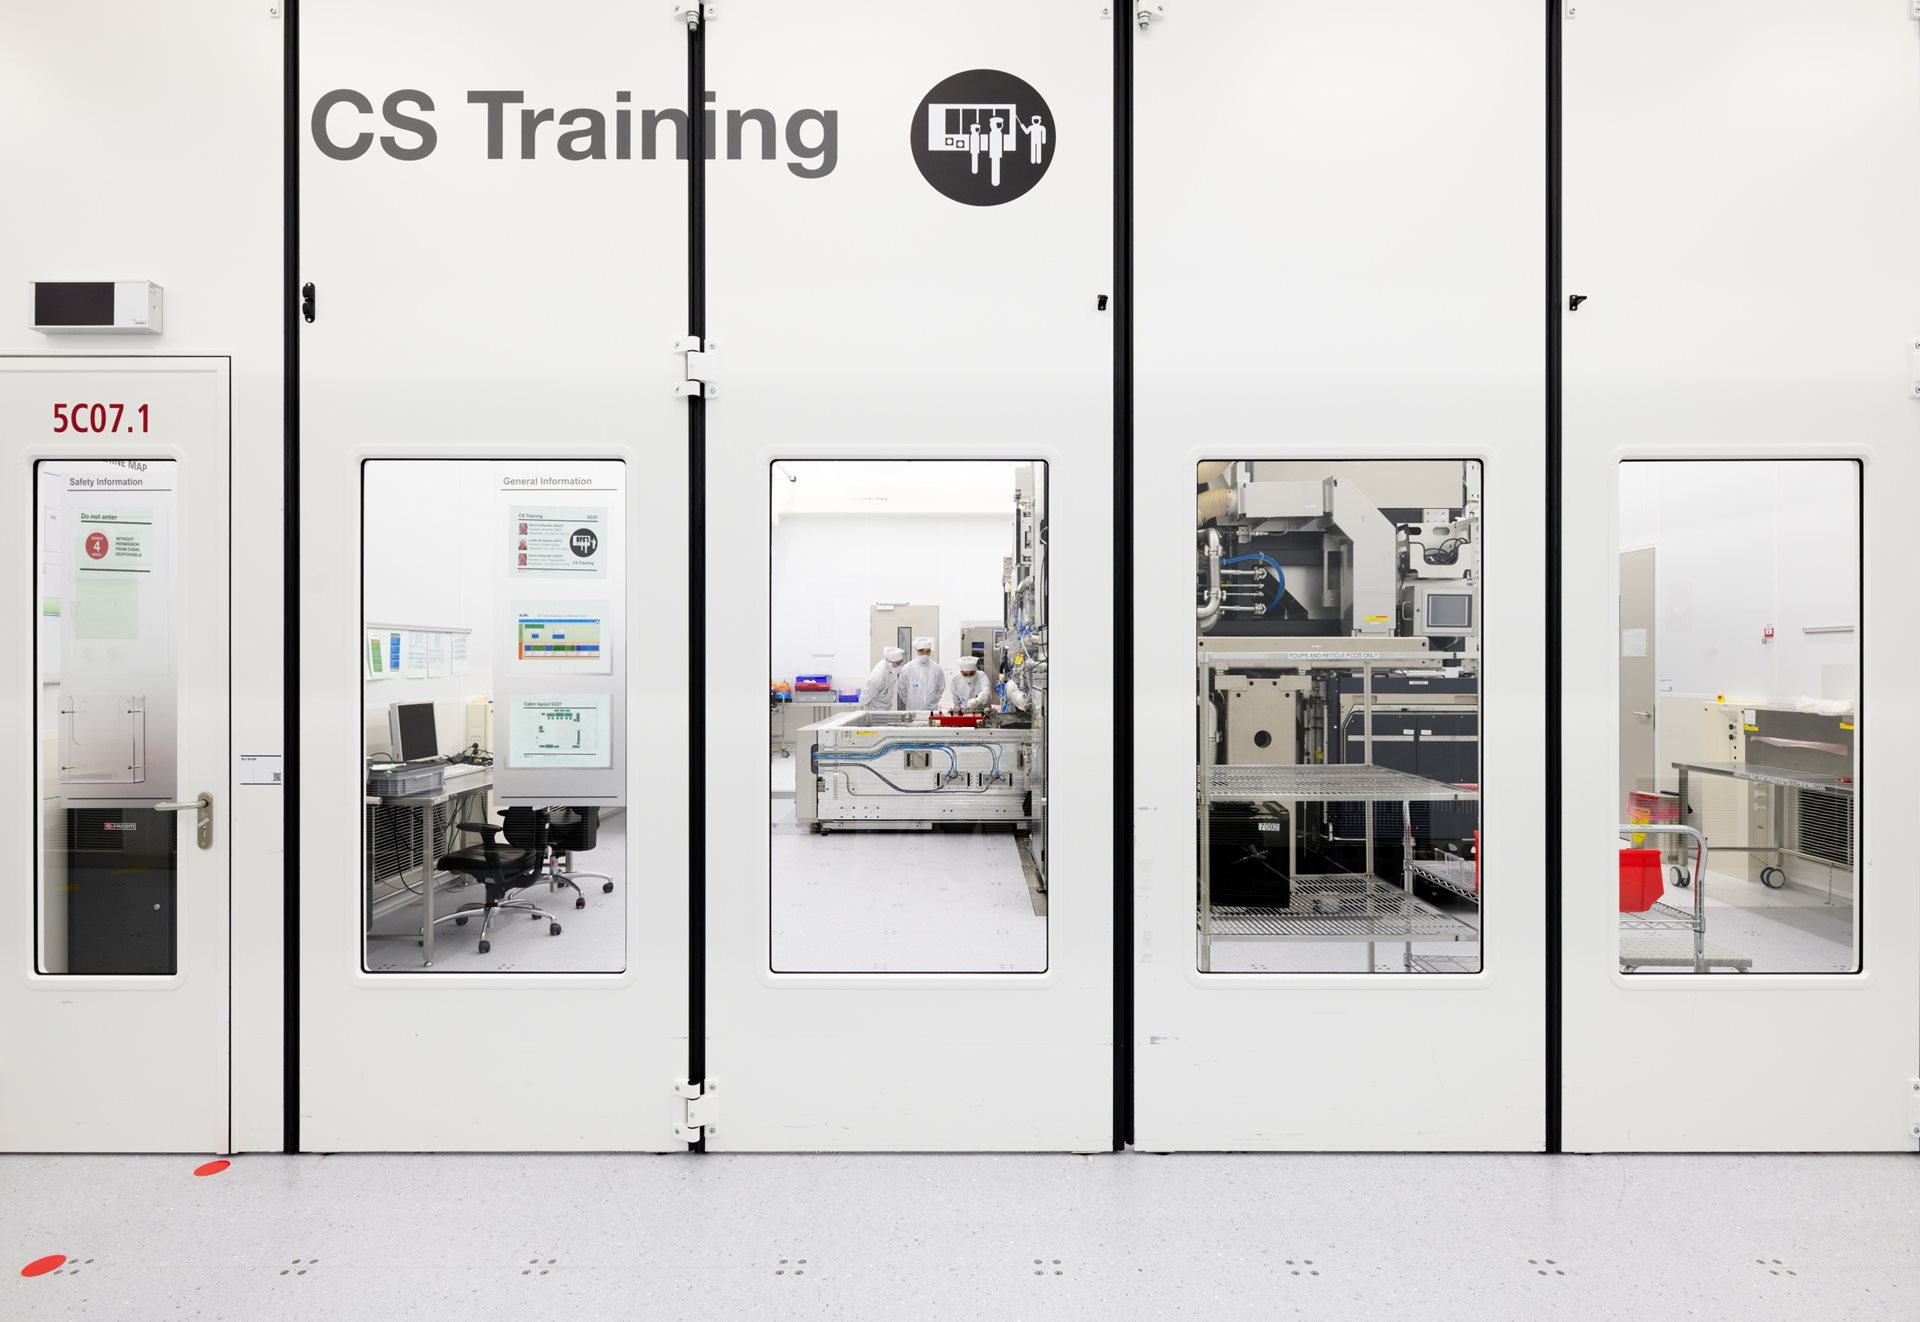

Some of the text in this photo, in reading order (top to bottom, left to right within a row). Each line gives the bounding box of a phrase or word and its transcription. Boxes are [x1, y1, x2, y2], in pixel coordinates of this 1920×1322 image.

[311, 88, 838, 179] CS Training
[53, 403, 149, 433] 5C07.1
[128, 461, 148, 473] MAP
[69, 477, 143, 488] Safety Information
[503, 476, 592, 486] General Information
[93, 540, 101, 552] 4
